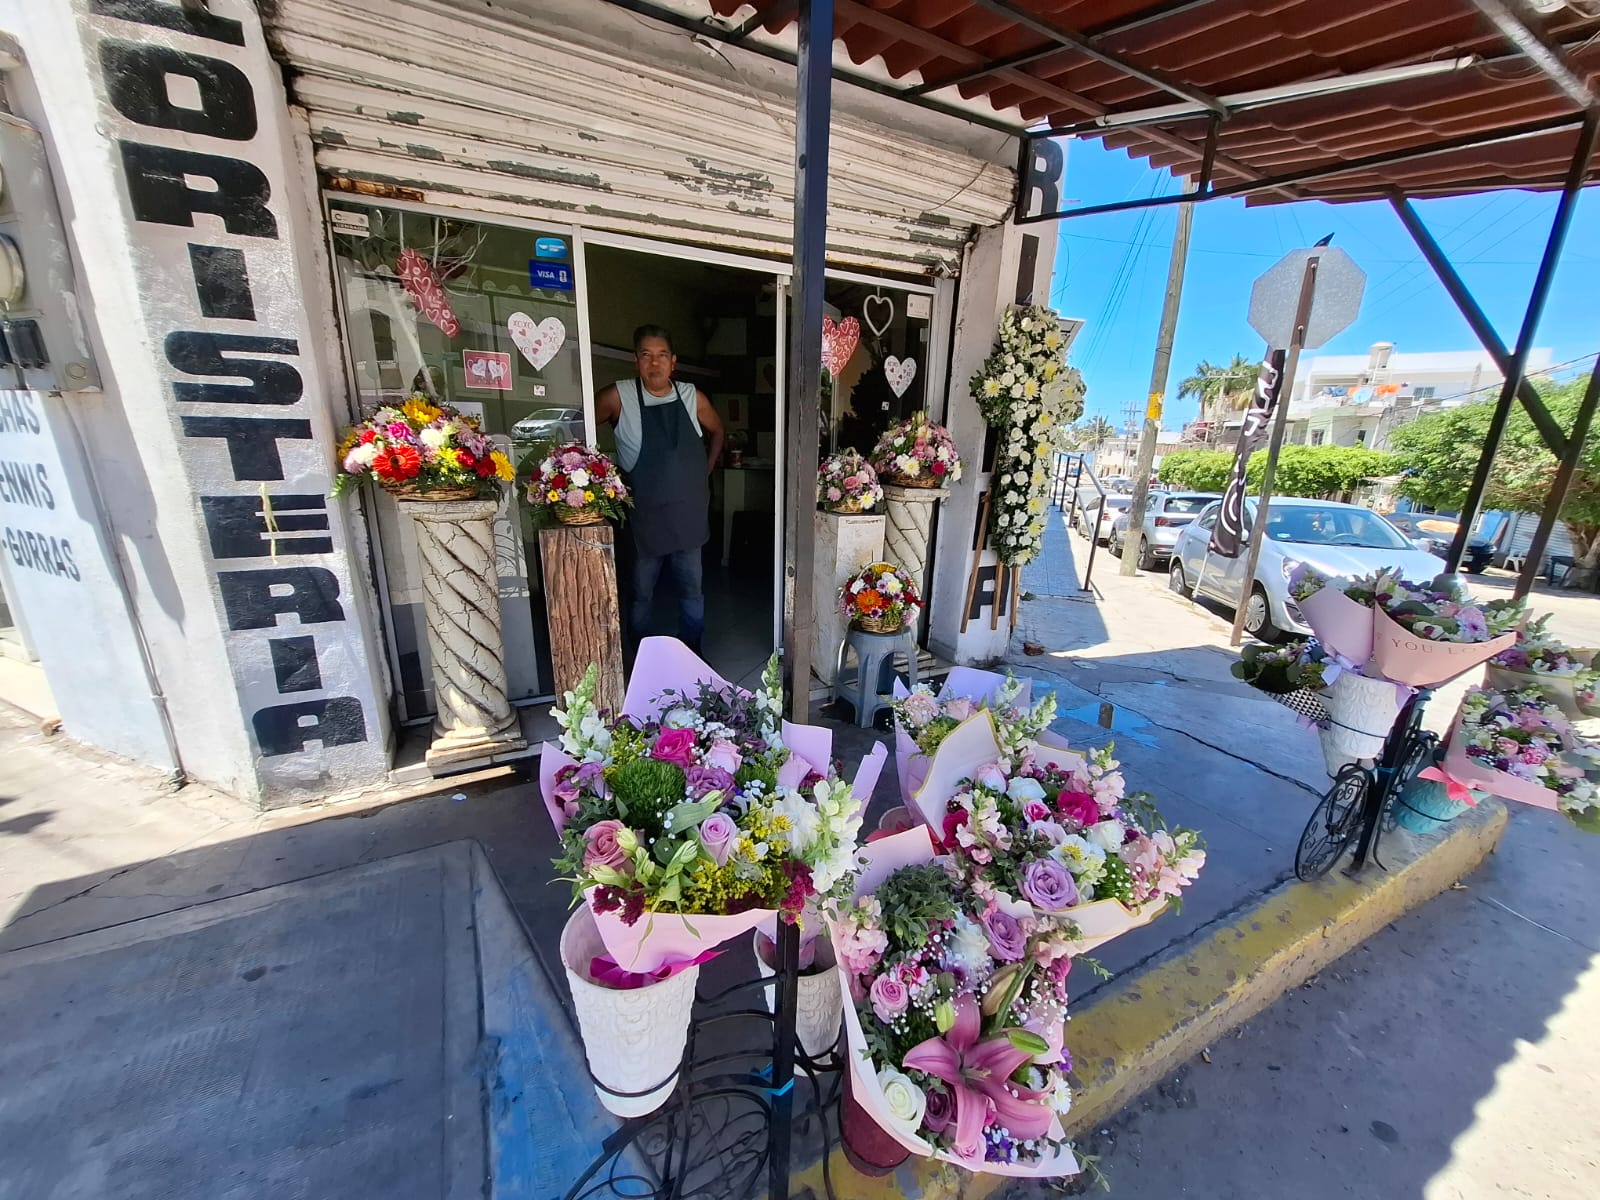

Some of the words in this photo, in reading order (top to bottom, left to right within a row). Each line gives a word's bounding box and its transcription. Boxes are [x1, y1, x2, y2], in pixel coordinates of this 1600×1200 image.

[537, 270, 555, 279] VISA
[0, 390, 41, 435] HAS
[1391, 638, 1433, 654] YOU
